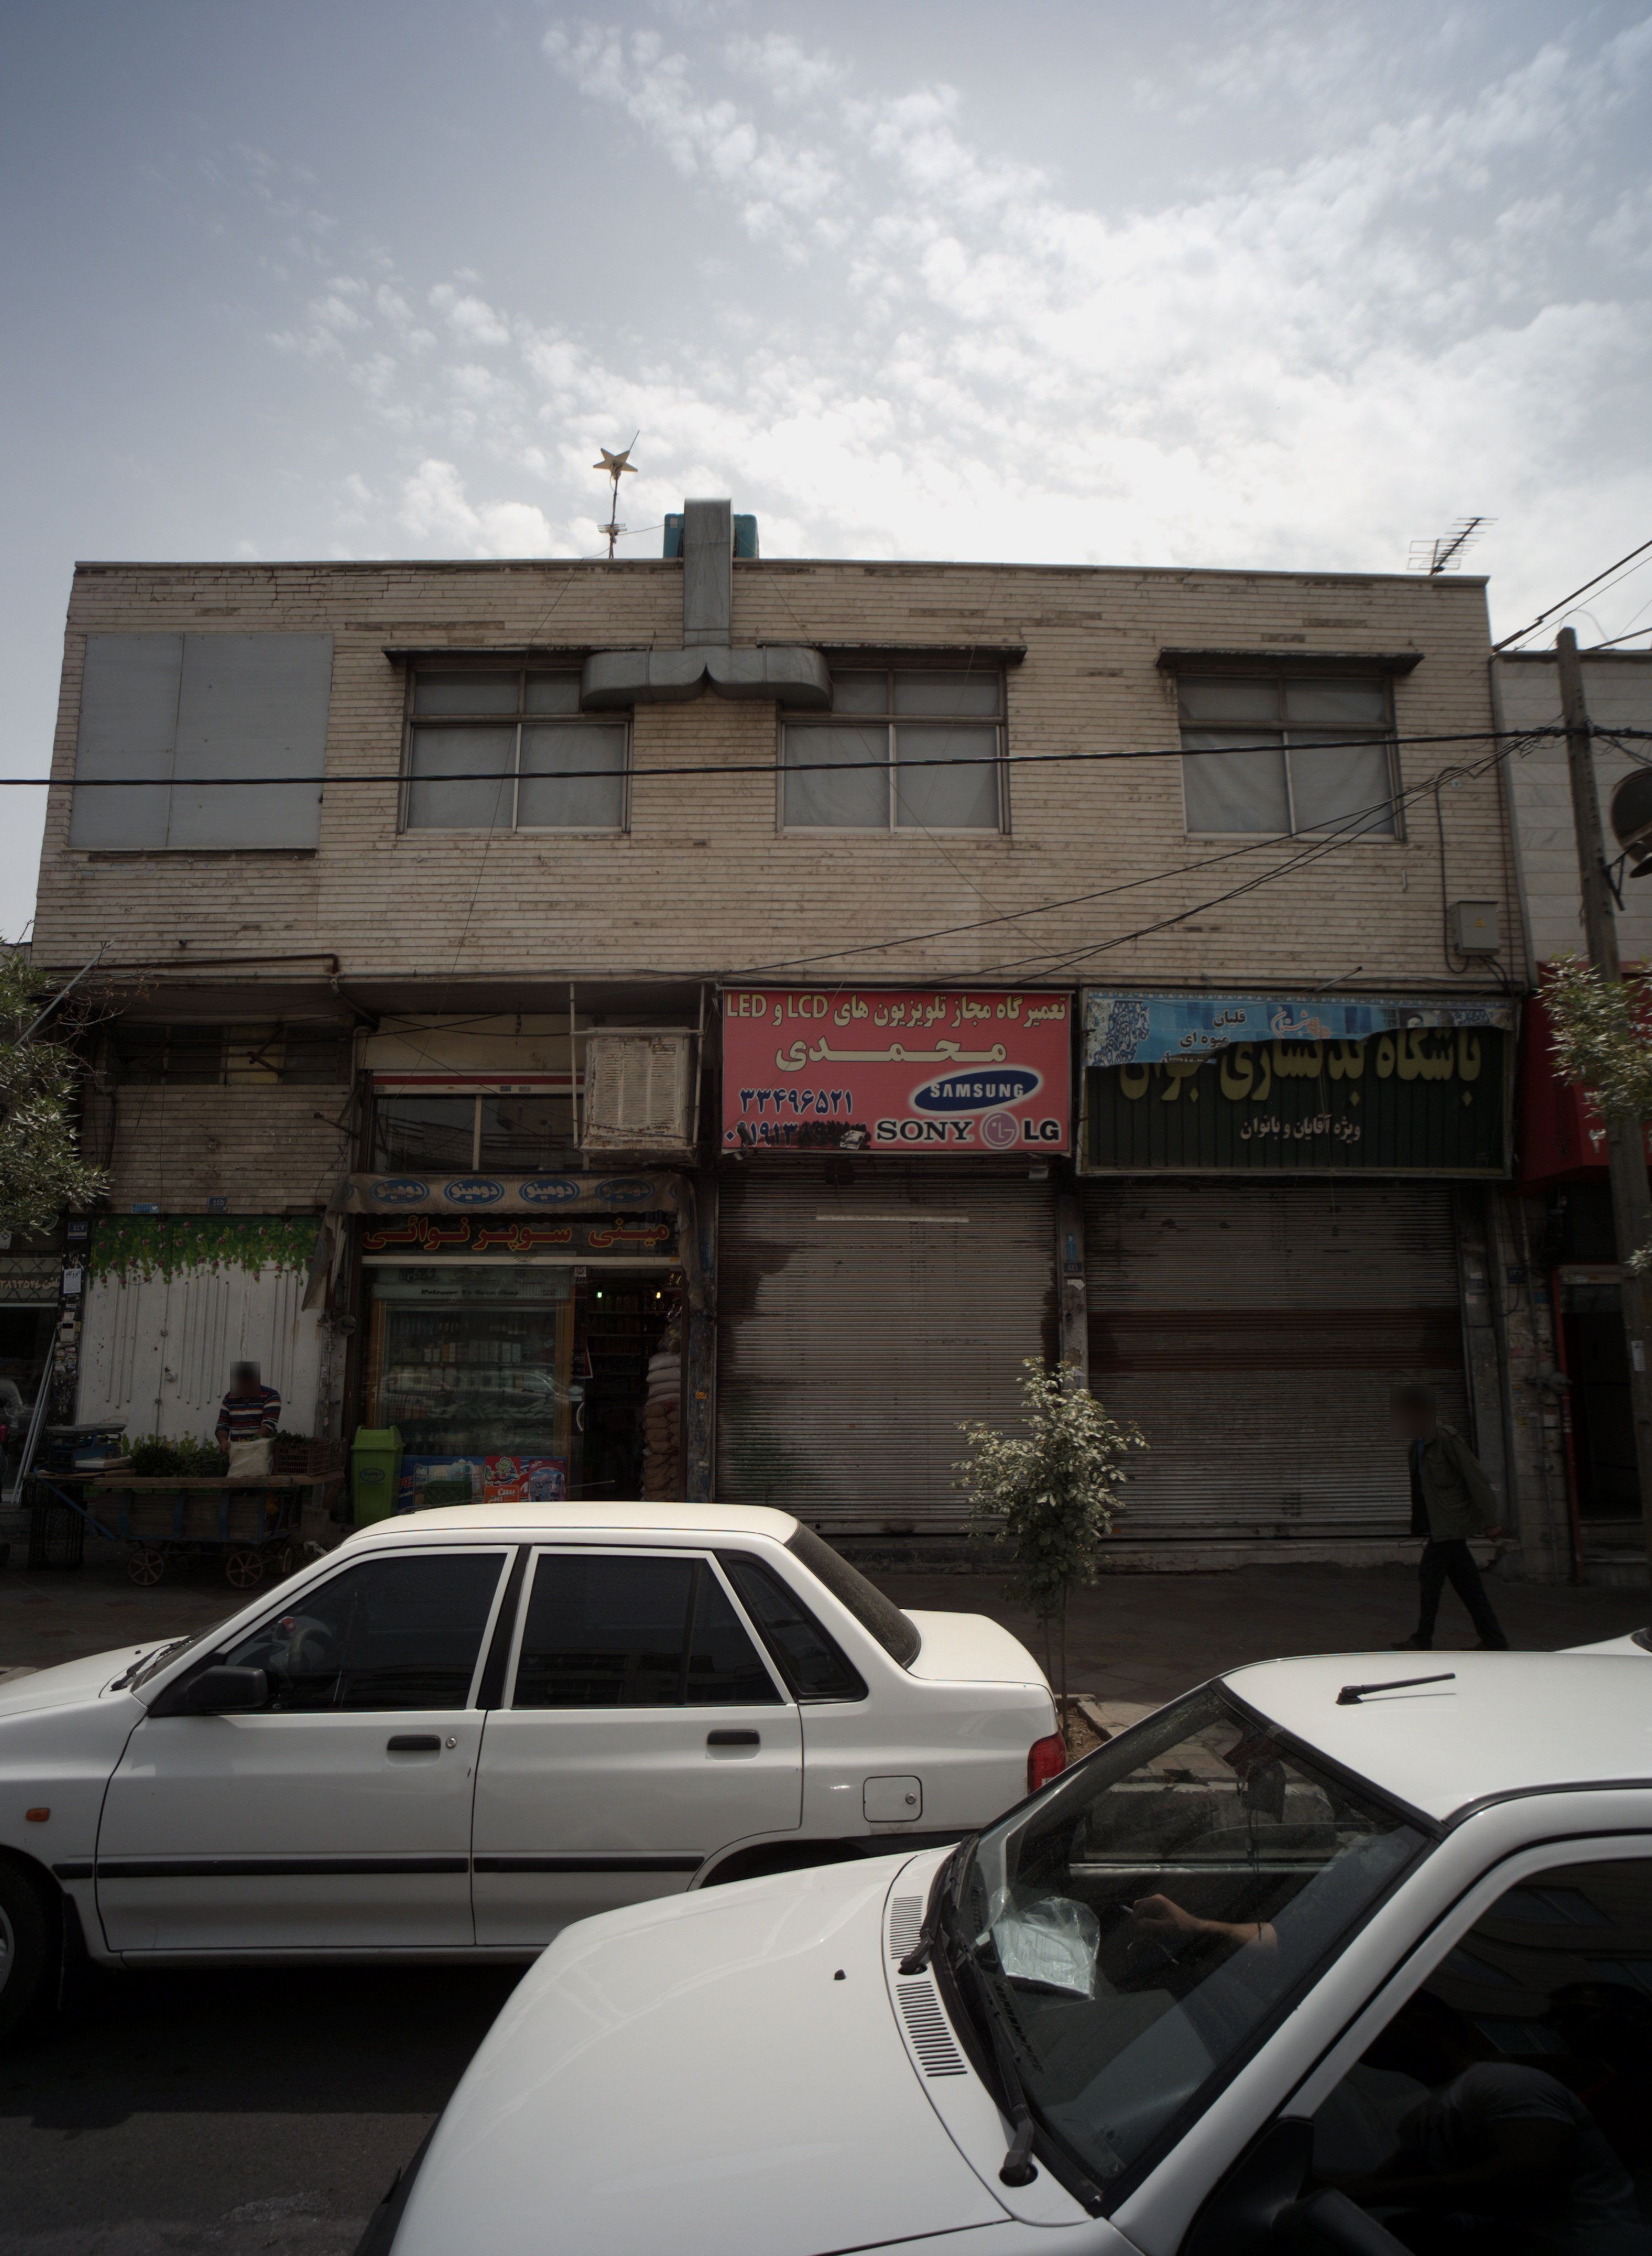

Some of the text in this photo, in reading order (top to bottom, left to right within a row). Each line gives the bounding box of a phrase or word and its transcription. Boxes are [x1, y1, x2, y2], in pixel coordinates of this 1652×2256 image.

[727, 994, 767, 1017] LED
[772, 1003, 783, 1026] و
[787, 994, 828, 1018] LCD
[834, 994, 870, 1027] های
[873, 994, 947, 1028] تلویزیون
[950, 994, 992, 1028] مجاز
[1213, 1009, 1246, 1027] قلیان
[775, 1035, 1007, 1071] محمدی
[740, 1088, 852, 1114] ۳۳۴۹۶۵۲۱
[930, 1083, 1024, 1098] SAMSUNG
[877, 1120, 1059, 1141] SONY LG
[1241, 1114, 1361, 1144] ویژه آقایان و بانوان
[472, 1223, 571, 1251] سوپر
[589, 1216, 670, 1248] مینی
